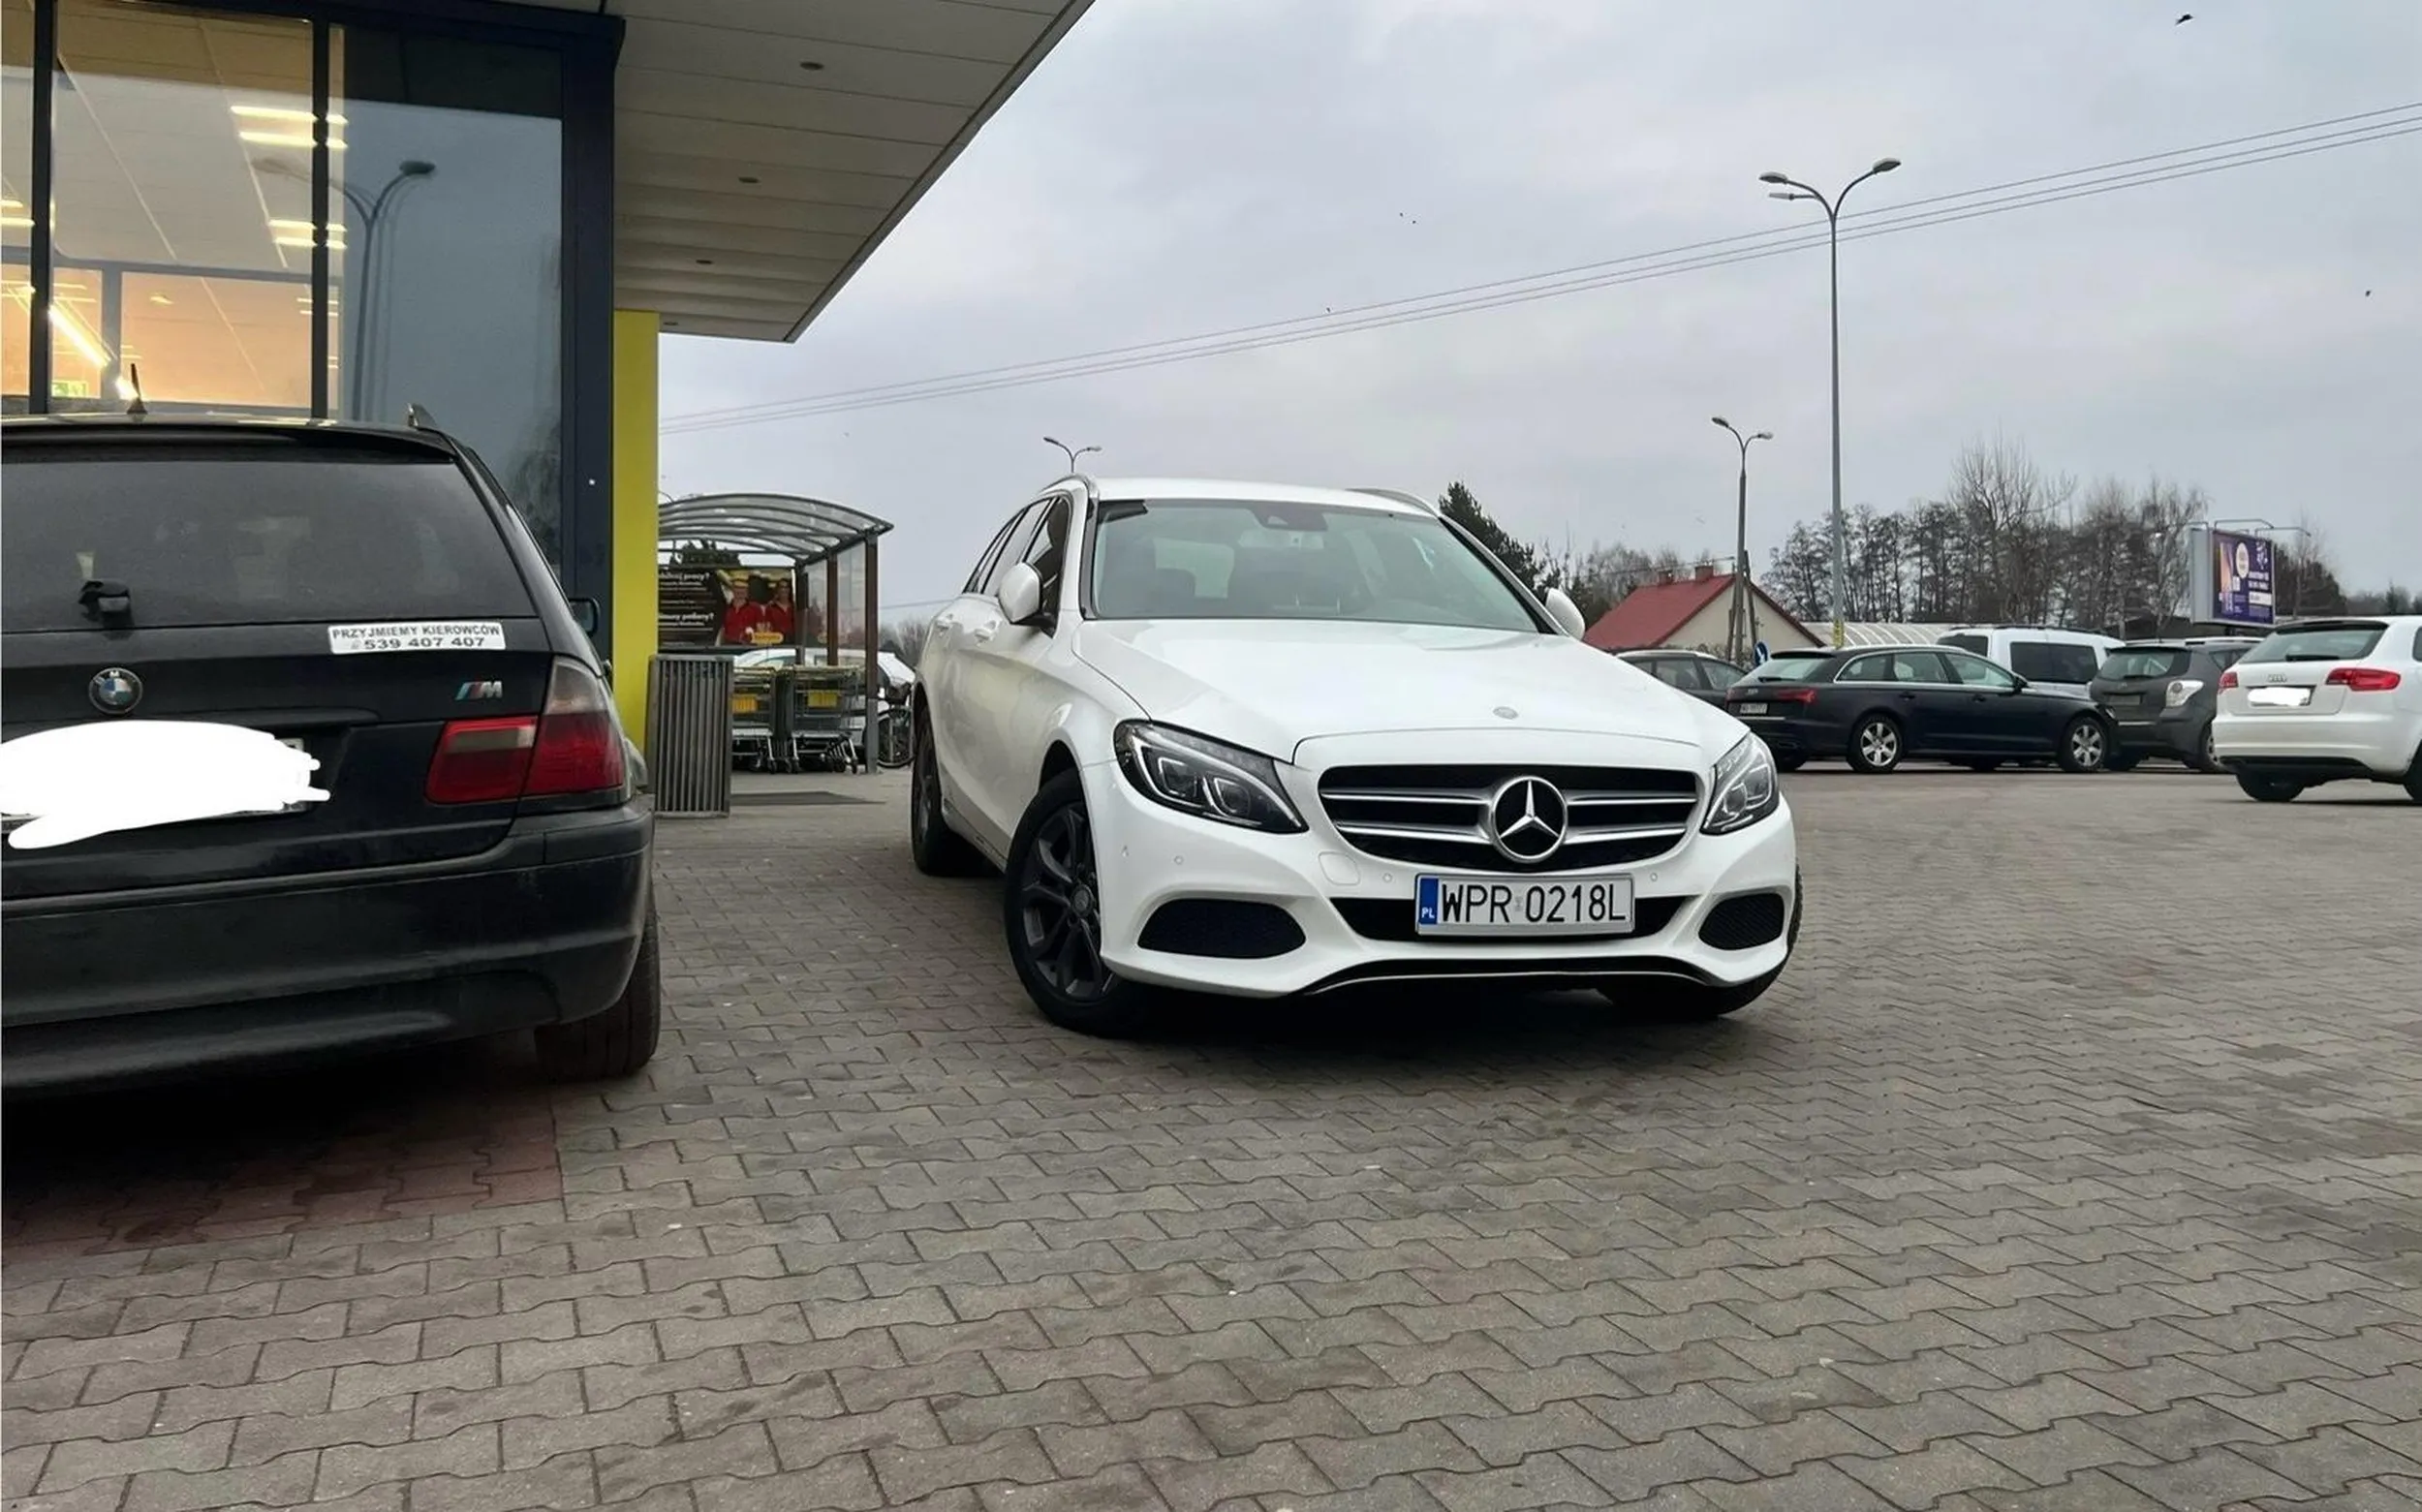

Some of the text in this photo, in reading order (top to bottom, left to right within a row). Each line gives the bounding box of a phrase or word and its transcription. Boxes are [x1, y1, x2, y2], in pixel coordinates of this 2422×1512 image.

[332, 625, 500, 638] PRZYJMIEMY KIEROWCÓW
[364, 636, 484, 649] 539 407 407
[1442, 883, 1626, 922] WPR 0218L
[1421, 907, 1435, 918] PL
